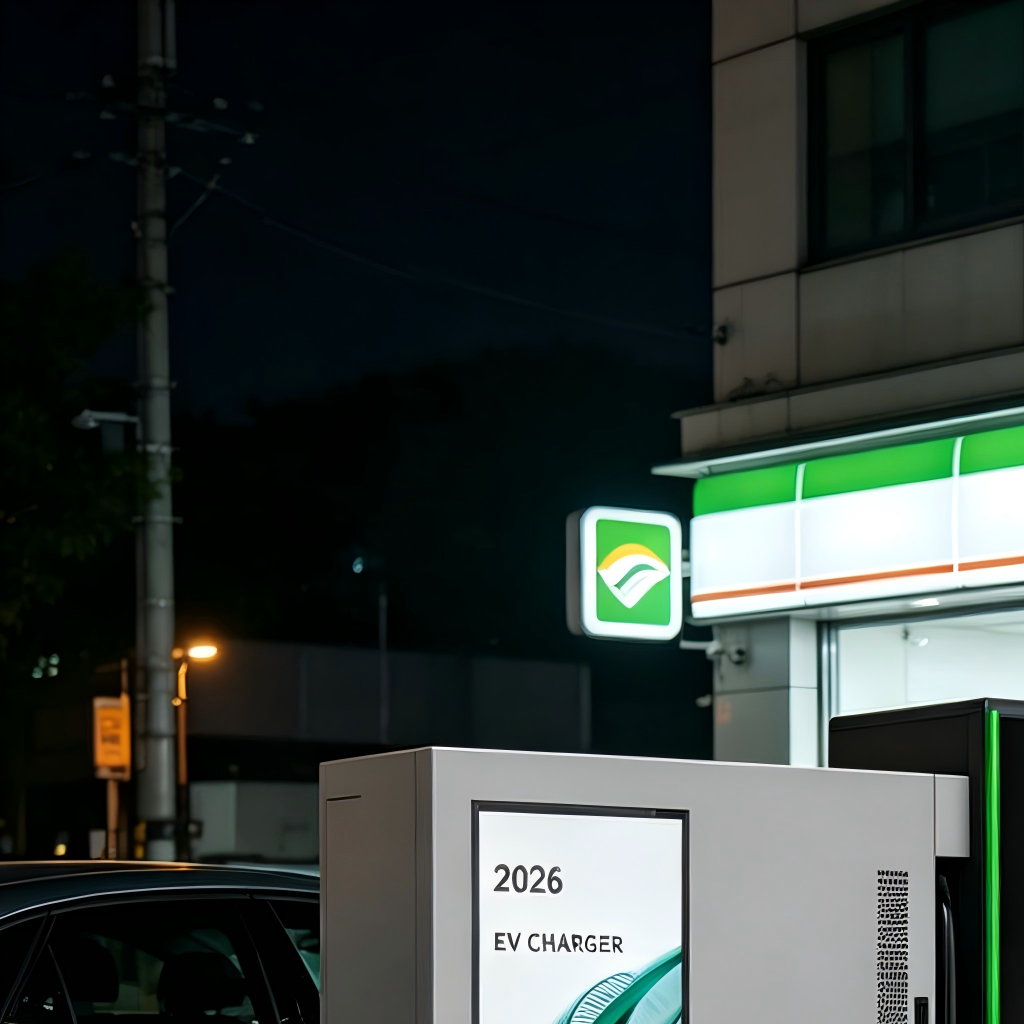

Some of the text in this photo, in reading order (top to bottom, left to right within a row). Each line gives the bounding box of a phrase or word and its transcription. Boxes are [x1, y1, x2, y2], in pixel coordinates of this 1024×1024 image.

[493, 863, 563, 895] 2026
[494, 932, 624, 954] EV CHARGER
